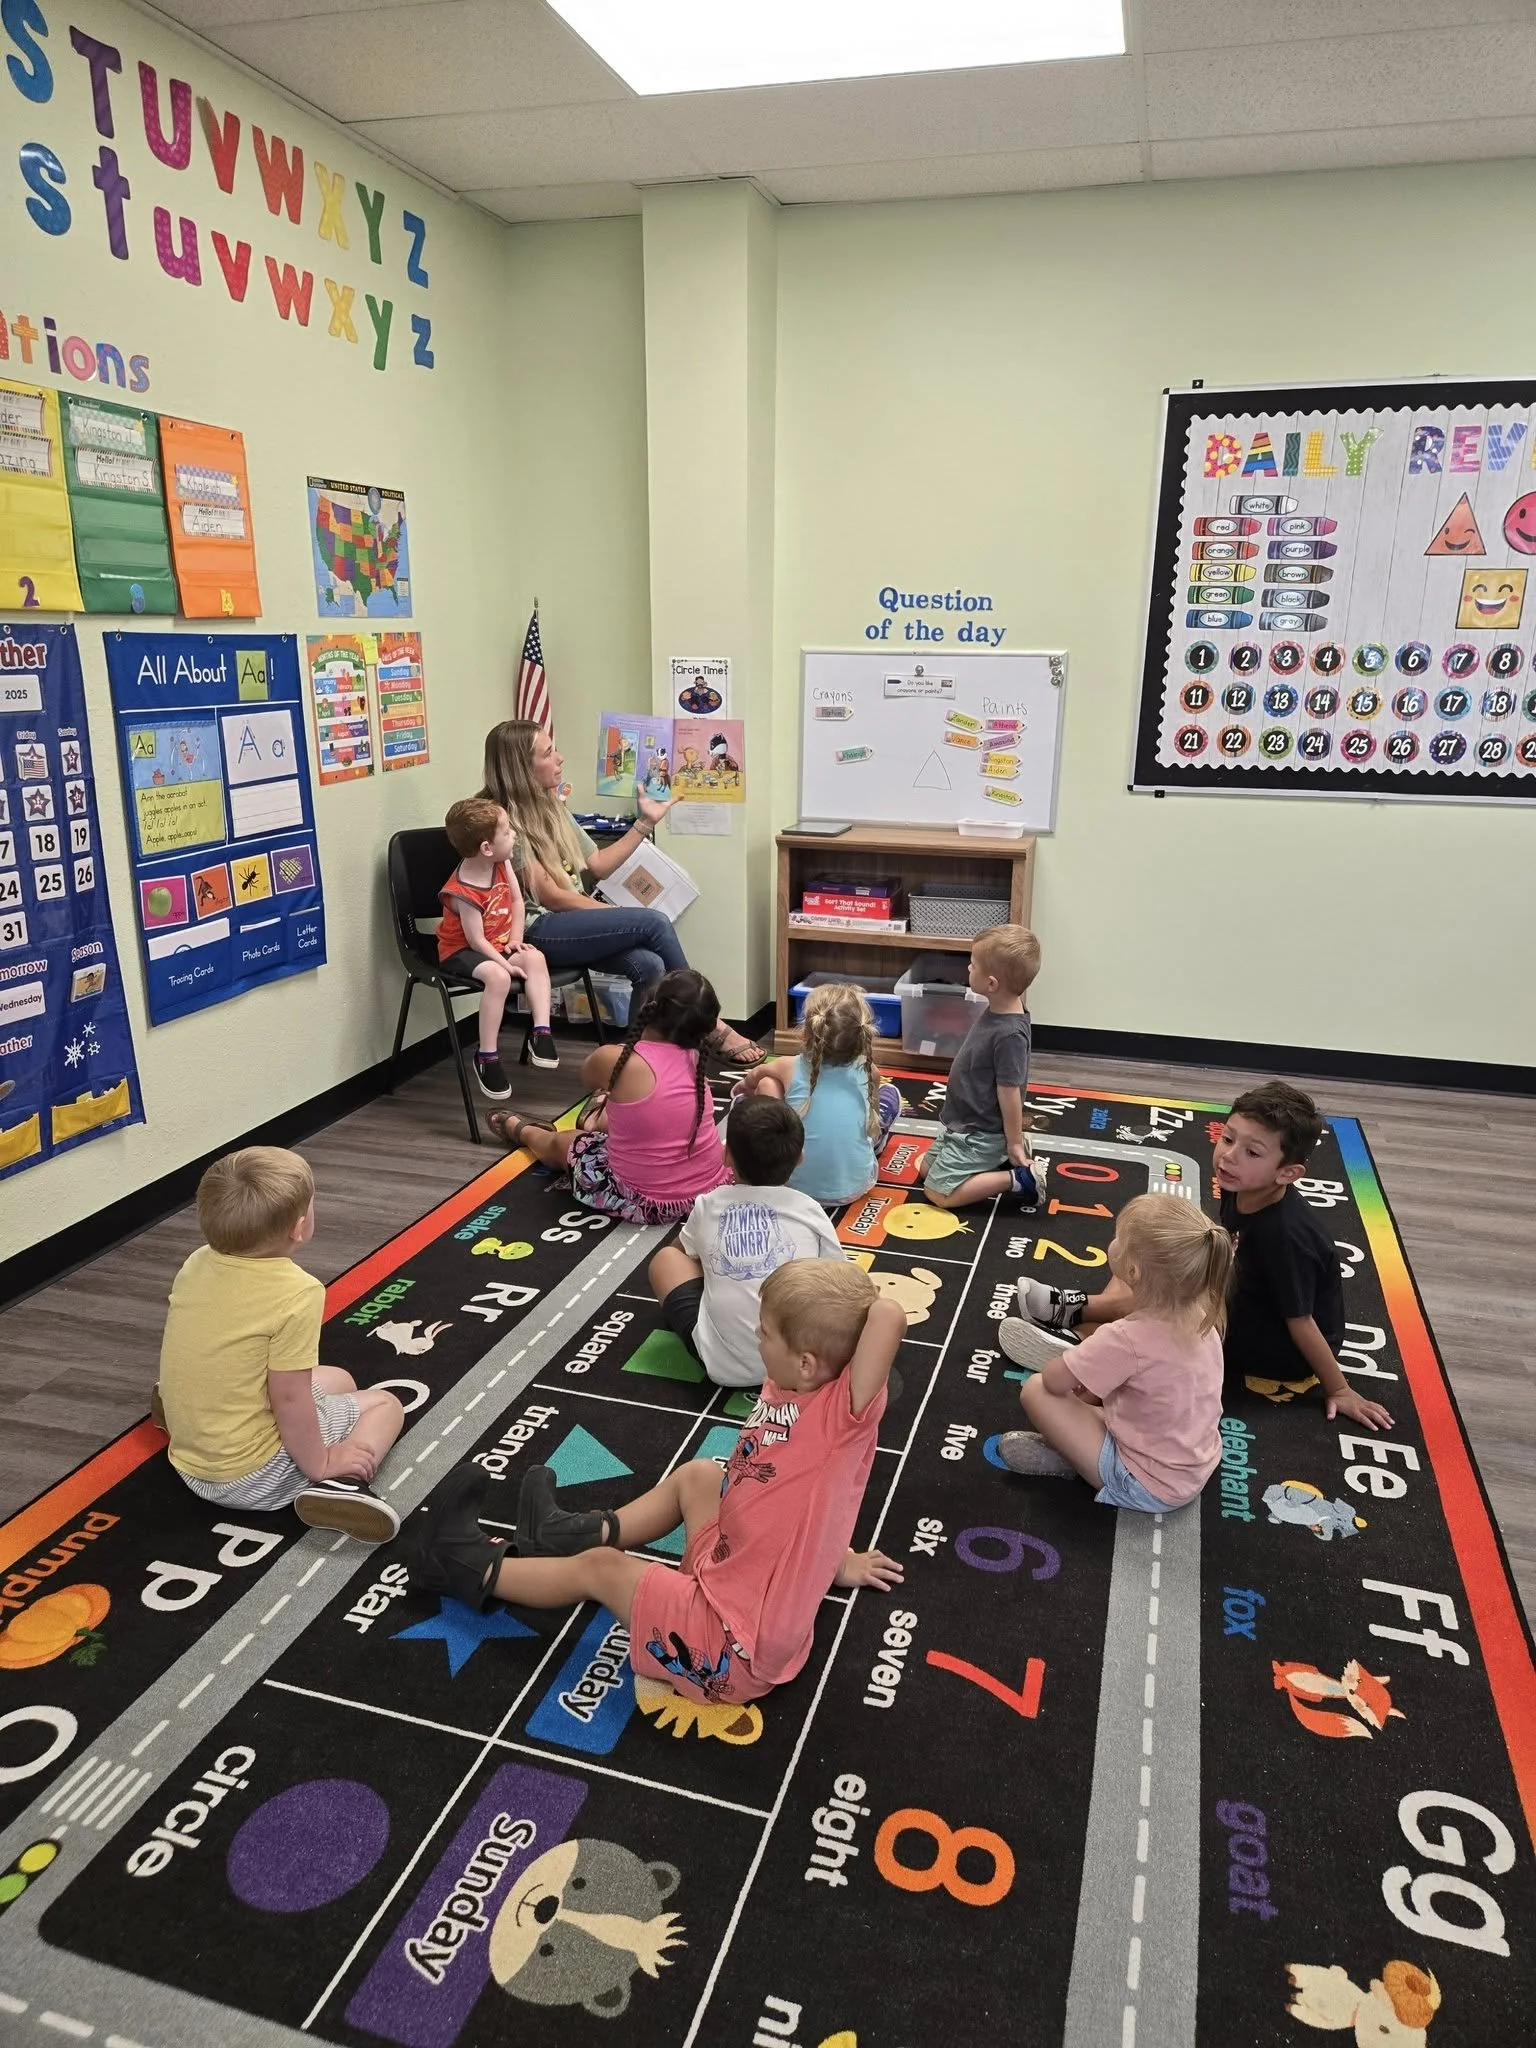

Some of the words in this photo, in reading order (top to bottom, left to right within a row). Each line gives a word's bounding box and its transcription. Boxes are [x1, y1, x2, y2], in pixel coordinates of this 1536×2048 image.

[2, 0, 53, 103] S
[69, 25, 122, 138] T
[138, 60, 192, 170] U
[196, 96, 240, 194] V
[252, 124, 304, 225] W
[314, 161, 348, 249] X
[355, 182, 385, 265] Y
[403, 210, 429, 289] Z
[92, 145, 130, 260] t
[153, 206, 202, 286] u
[365, 294, 393, 371] y
[1203, 427, 1384, 478] DAILY
[94, 463, 140, 485] Kingston
[330, 482, 349, 491] UNITED
[349, 485, 366, 494] STATES
[381, 490, 404, 499] POLITICAL
[1249, 500, 1270, 509] white
[191, 516, 223, 534] Aiden
[1216, 523, 1230, 531] red
[1289, 523, 1306, 532] pink
[1207, 547, 1234, 555] orange
[1285, 545, 1310, 554] purple
[1207, 568, 1230, 576] yellow
[1282, 569, 1306, 578] brown
[18, 576, 40, 607] 2
[878, 587, 993, 613] Question
[1205, 591, 1228, 599] green
[1281, 594, 1301, 603] black
[1207, 613, 1222, 622] blue
[1279, 617, 1298, 626] gray
[865, 618, 892, 640] of
[904, 620, 944, 641] the
[957, 621, 1007, 647] day
[137, 655, 167, 685] All
[173, 654, 227, 684] About
[241, 658, 266, 684] Aa
[390, 667, 409, 677] Sunday
[676, 665, 700, 675] Circle
[702, 665, 724, 675] Time
[1198, 649, 1205, 666] 1
[1240, 650, 1250, 667] 2
[1282, 650, 1292, 667] 3
[1322, 650, 1332, 669] 4
[1365, 652, 1376, 668] 5
[1408, 651, 1419, 667] 6
[1456, 653, 1467, 669] 7
[1499, 652, 1511, 670] 8
[5, 690, 28, 700] 2025
[391, 693, 413, 702] Tuesday
[813, 687, 853, 704] Crayons
[983, 697, 1027, 715] Paints
[1190, 688, 1203, 706] 11
[1231, 690, 1247, 707] 12
[1273, 692, 1289, 709] 13
[1314, 694, 1330, 711] 14
[1355, 697, 1373, 713] 15
[1401, 696, 1419, 713] 16
[1444, 695, 1463, 712] 17
[1489, 695, 1507, 713] 18
[392, 718, 415, 728] Thursday
[396, 731, 413, 740] Friday
[238, 725, 262, 764] A
[272, 739, 286, 757] a
[394, 743, 418, 753] Saturday
[1183, 732, 1198, 749] 21
[1225, 732, 1242, 749] 22
[1267, 734, 1285, 751] 23
[1306, 736, 1324, 753] 24
[1350, 737, 1368, 755] 25
[1392, 738, 1411, 756] 26
[1439, 739, 1457, 756] 27
[1482, 741, 1503, 759] 28
[35, 833, 55, 852] 18
[74, 828, 87, 847] 19
[39, 874, 62, 893] 25
[77, 865, 92, 886] 26
[855, 900, 876, 908] Sound!
[3, 921, 23, 941] 31
[296, 925, 317, 937] Letter
[298, 937, 317, 949] Cards
[242, 949, 261, 962] Photo
[262, 943, 280, 956] Cards
[169, 971, 193, 987] Tracing
[194, 964, 214, 978] Cards
[1023, 1097, 1077, 1115] Yy
[1150, 1106, 1194, 1128] Zz
[1090, 1108, 1112, 1131] zebra
[882, 1143, 919, 1175] Monday
[1056, 1162, 1119, 1182] 0
[727, 1208, 768, 1234] ALWAYS
[847, 1196, 889, 1235] Tuesday
[1048, 1199, 1114, 1218] 1
[454, 1205, 507, 1240] snake
[541, 1210, 611, 1243] Ss
[725, 1231, 770, 1257] HUNGRY
[1005, 1236, 1032, 1259] two
[1033, 1238, 1108, 1267] 2
[344, 1278, 416, 1326] rabbit
[460, 1281, 540, 1323] Rr
[986, 1284, 1018, 1320] three
[564, 1310, 635, 1374] square
[966, 1349, 1001, 1384] four
[941, 1423, 978, 1461] five
[1220, 1417, 1257, 1522] elephant
[1338, 1434, 1420, 1499] Ee
[909, 1517, 948, 1557] six
[954, 1526, 1061, 1580] 6
[141, 1522, 284, 1611] Pp
[343, 1562, 410, 1634] star
[1222, 1586, 1266, 1640] fox
[1362, 1578, 1470, 1666] Ff
[862, 1610, 918, 1708] seven
[926, 1649, 1045, 1719] 7
[126, 1744, 256, 1877] circle
[805, 1773, 871, 1887] eight
[873, 1808, 1015, 1906] 8
[1216, 1800, 1279, 1921] goat
[1382, 1790, 1516, 1957] Gg
[405, 1811, 537, 1985] Sunday
